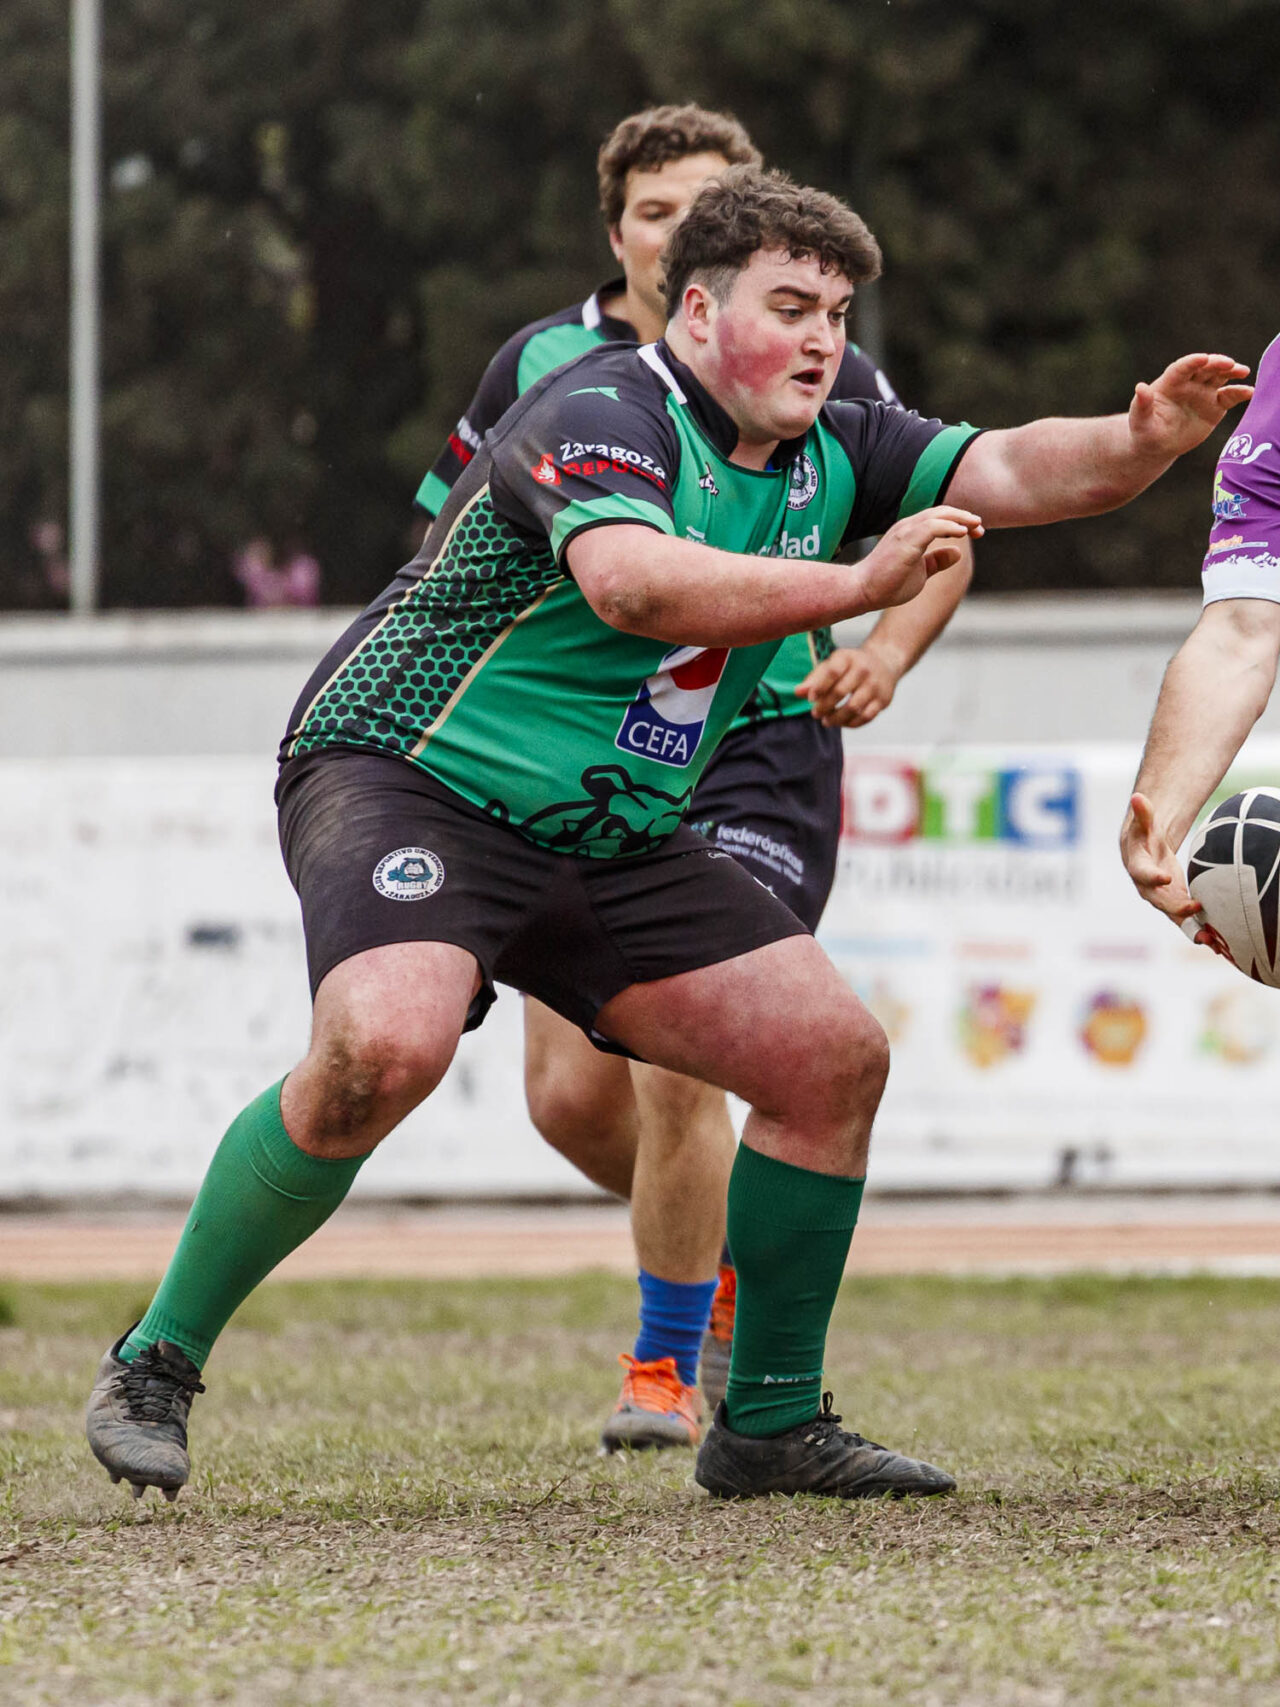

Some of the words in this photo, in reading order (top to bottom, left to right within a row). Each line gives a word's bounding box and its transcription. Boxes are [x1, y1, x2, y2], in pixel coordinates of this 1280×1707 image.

[560, 442, 666, 479] Zaragoza
[628, 721, 688, 761] CEFA
[852, 771, 1069, 833] DTC
